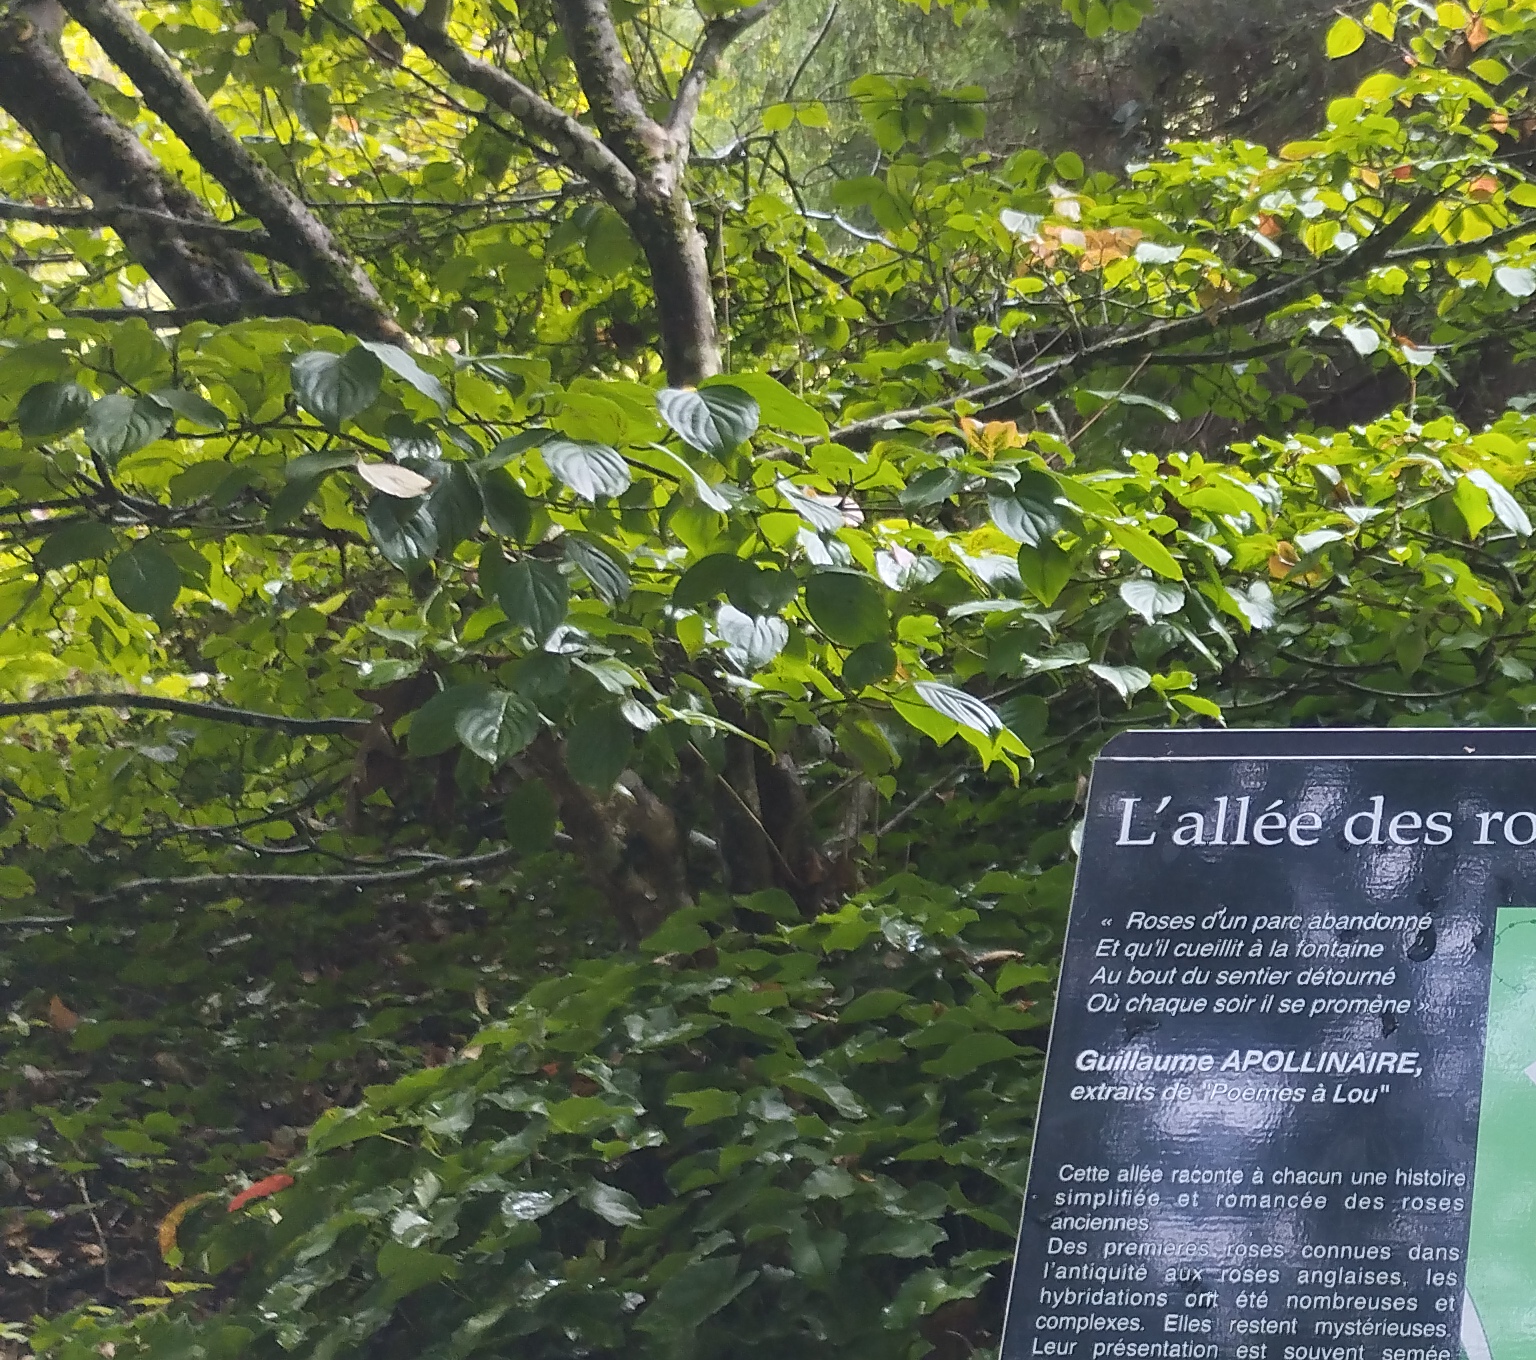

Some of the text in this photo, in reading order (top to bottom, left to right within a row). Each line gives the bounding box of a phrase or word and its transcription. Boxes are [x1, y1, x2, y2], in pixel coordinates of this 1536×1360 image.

[1118, 797, 1321, 845] L'allée
[1345, 797, 1453, 846] des
[1126, 912, 1195, 930] Roses
[1202, 911, 1247, 931] d'un
[1251, 915, 1302, 933] parc
[1309, 912, 1432, 930] abandonné
[1096, 940, 1384, 961] Et qu'il cueillit à la fontaine
[1090, 967, 1396, 986] Au bout du sentier détourné
[1087, 994, 1119, 1012] Où
[1125, 994, 1207, 1016] chaque
[1213, 995, 1255, 1012] soir
[1260, 995, 1273, 1012] il
[1278, 998, 1305, 1013] se
[1309, 996, 1411, 1017] promène
[1076, 1050, 1423, 1077] Guillaume APOLLINAIRE,
[1070, 1084, 1155, 1101] extraits
[1163, 1084, 1191, 1101] de
[1312, 1084, 1326, 1102] à
[1333, 1084, 1390, 1103] Lou"
[1059, 1164, 1465, 1186] Cette allée raconte à chacun une histoire
[1035, 1314, 1451, 1339] complexes. Elles restent mystérieuses.
[1033, 1338, 1077, 1355] Leur
[1093, 1338, 1218, 1359] présentation
[1236, 1344, 1267, 1359] est
